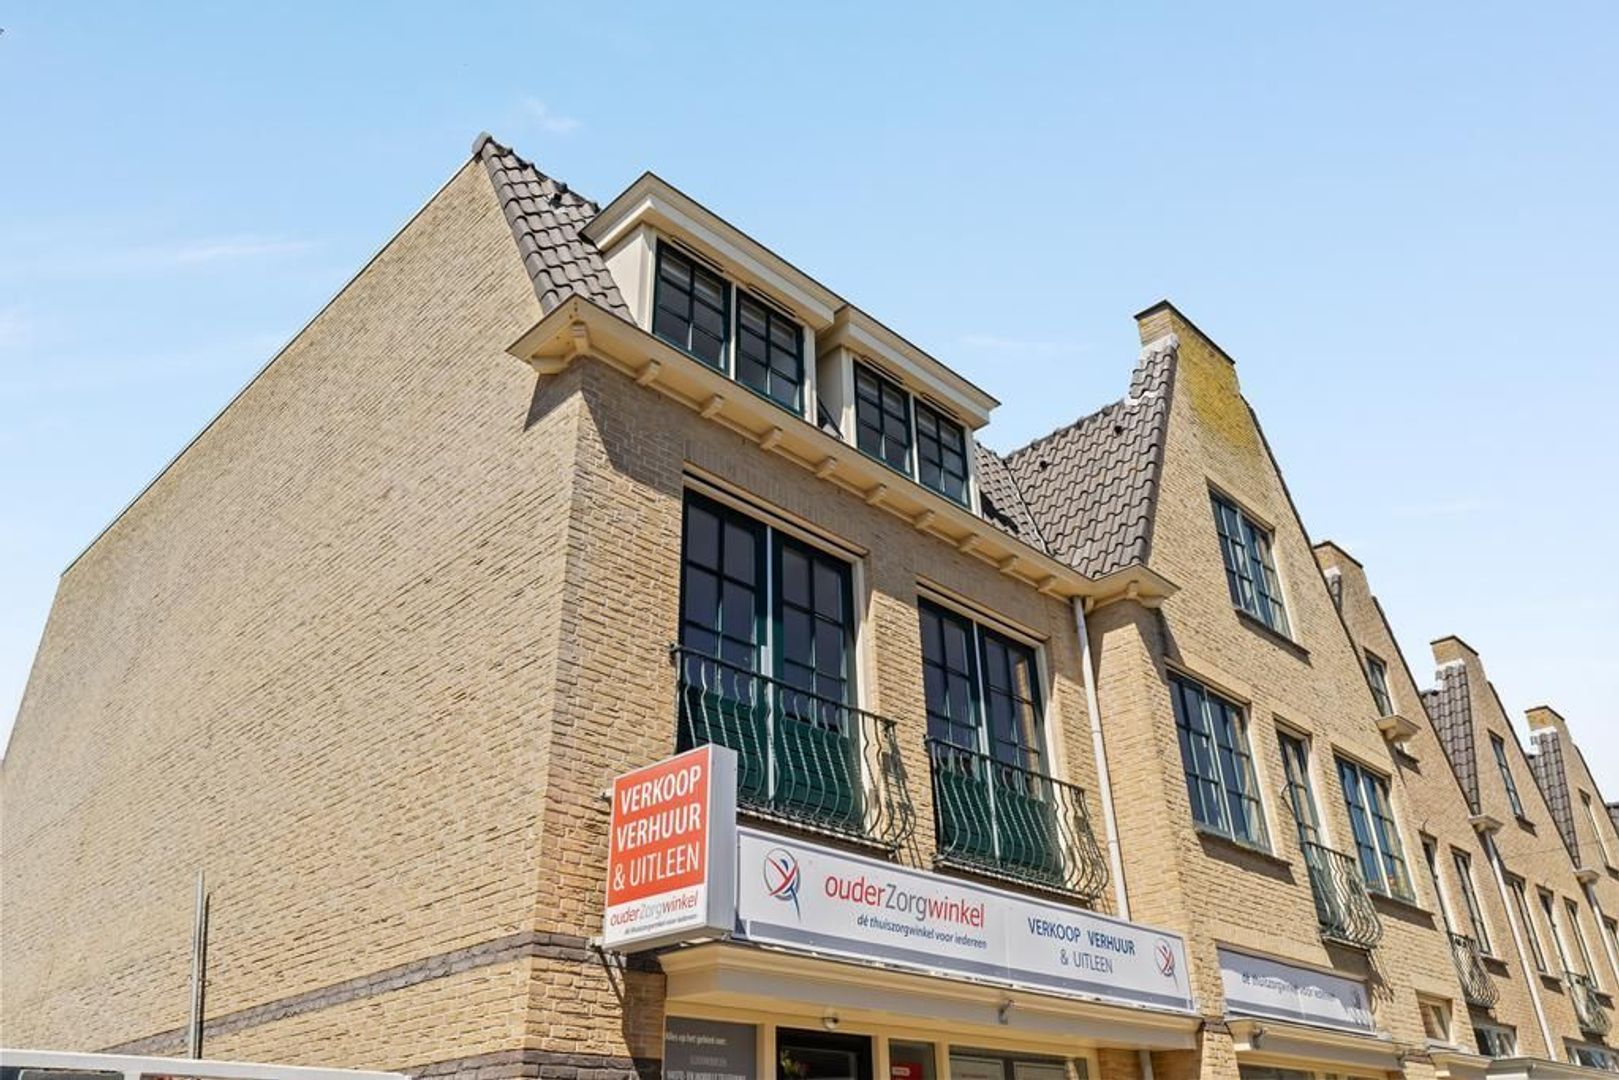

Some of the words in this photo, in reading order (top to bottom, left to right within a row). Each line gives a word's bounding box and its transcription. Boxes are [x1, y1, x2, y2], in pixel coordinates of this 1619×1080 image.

[620, 765, 702, 815] VERKOOP
[616, 803, 701, 852] VERHUUR
[613, 864, 625, 891] &
[630, 842, 700, 887] UITLEEN
[610, 890, 699, 927] ouderZorgwinkel
[825, 874, 984, 928] ouderZorgwinkel
[870, 918, 935, 939] thuiszorgwinkel
[935, 931, 954, 942] voor
[955, 931, 988, 949] iedereen
[1028, 917, 1081, 944] VERKOOP
[1087, 930, 1136, 955] VERHUUR
[1060, 949, 1069, 965] &
[1073, 951, 1114, 974] UITLEEN
